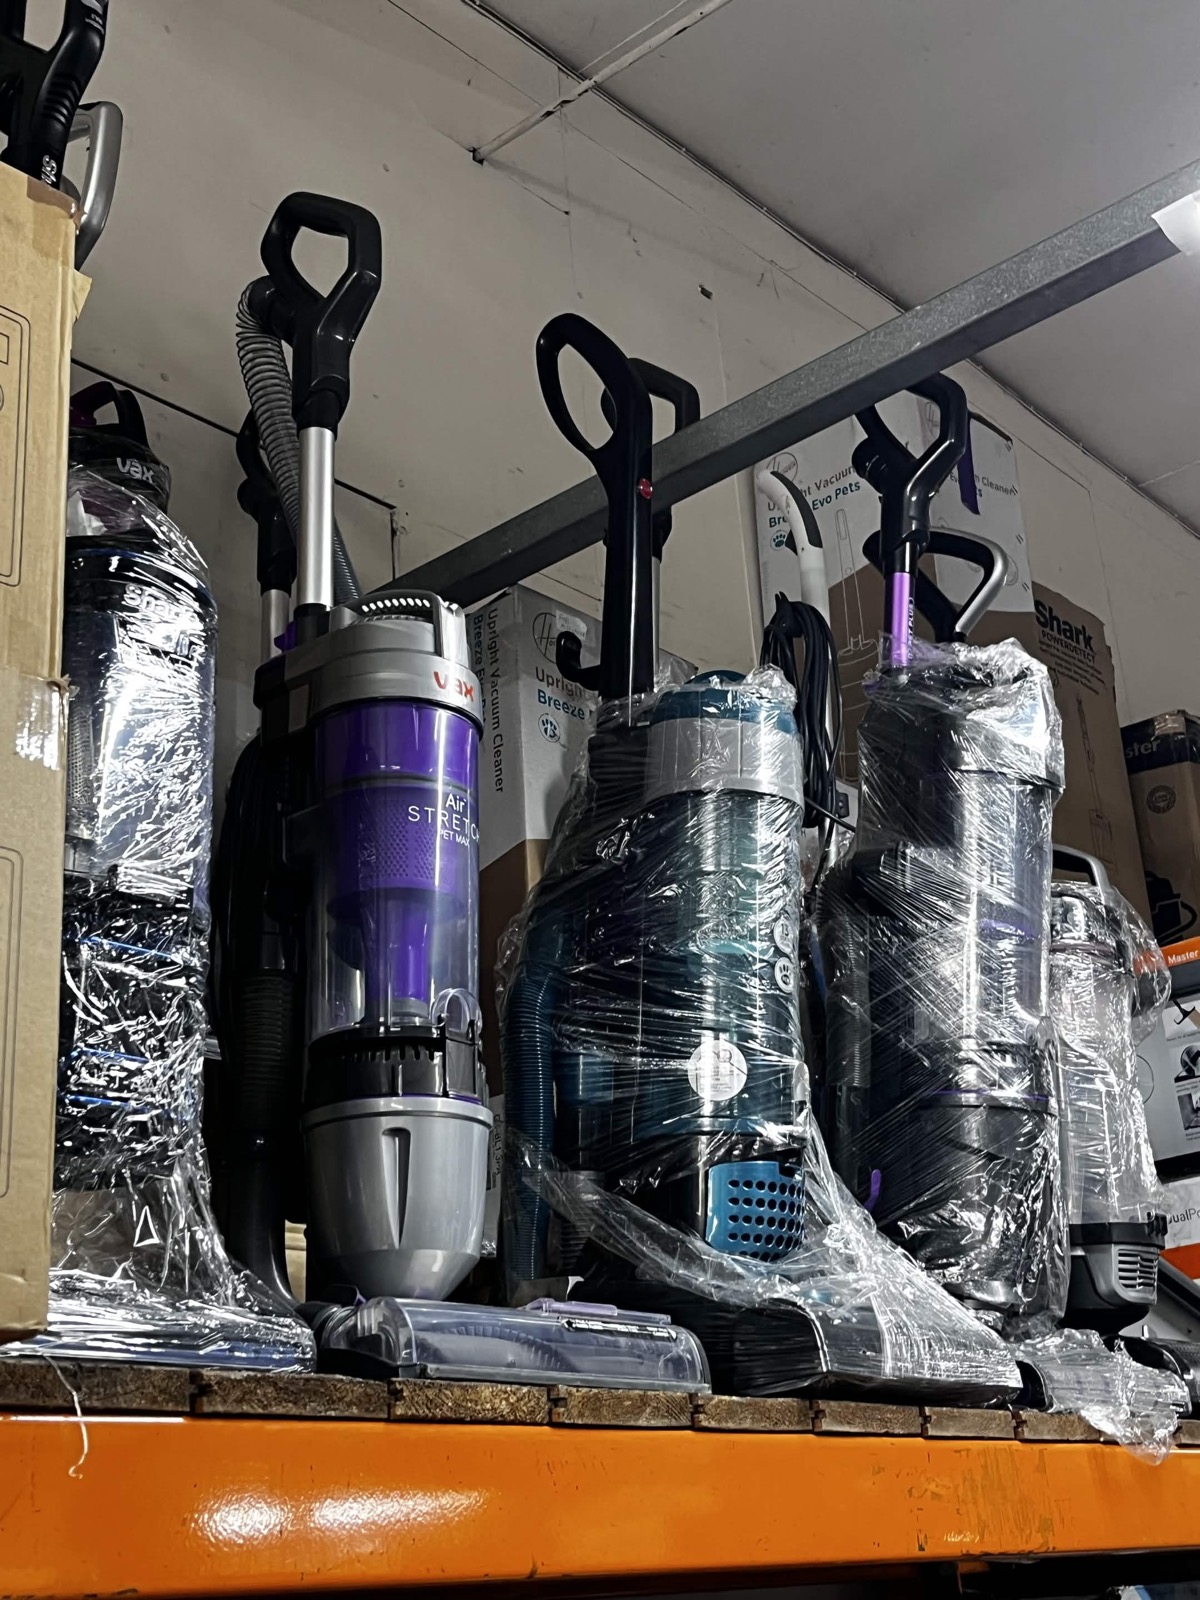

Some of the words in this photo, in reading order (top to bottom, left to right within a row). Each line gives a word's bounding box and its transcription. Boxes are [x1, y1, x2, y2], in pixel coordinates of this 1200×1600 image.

[116, 457, 155, 483] vax
[811, 495, 833, 511] Evo
[834, 481, 861, 500] Pets
[473, 613, 483, 666] Breeze
[486, 608, 500, 667] Upright
[1033, 600, 1097, 656] Shark
[490, 669, 501, 731] Vacuum
[537, 688, 586, 720] Breeze
[492, 733, 504, 793] Cleaner
[1125, 740, 1161, 759] ster
[446, 793, 467, 813] Air
[439, 829, 454, 841] PET
[455, 830, 470, 847] MAX
[1167, 949, 1199, 965] Master
